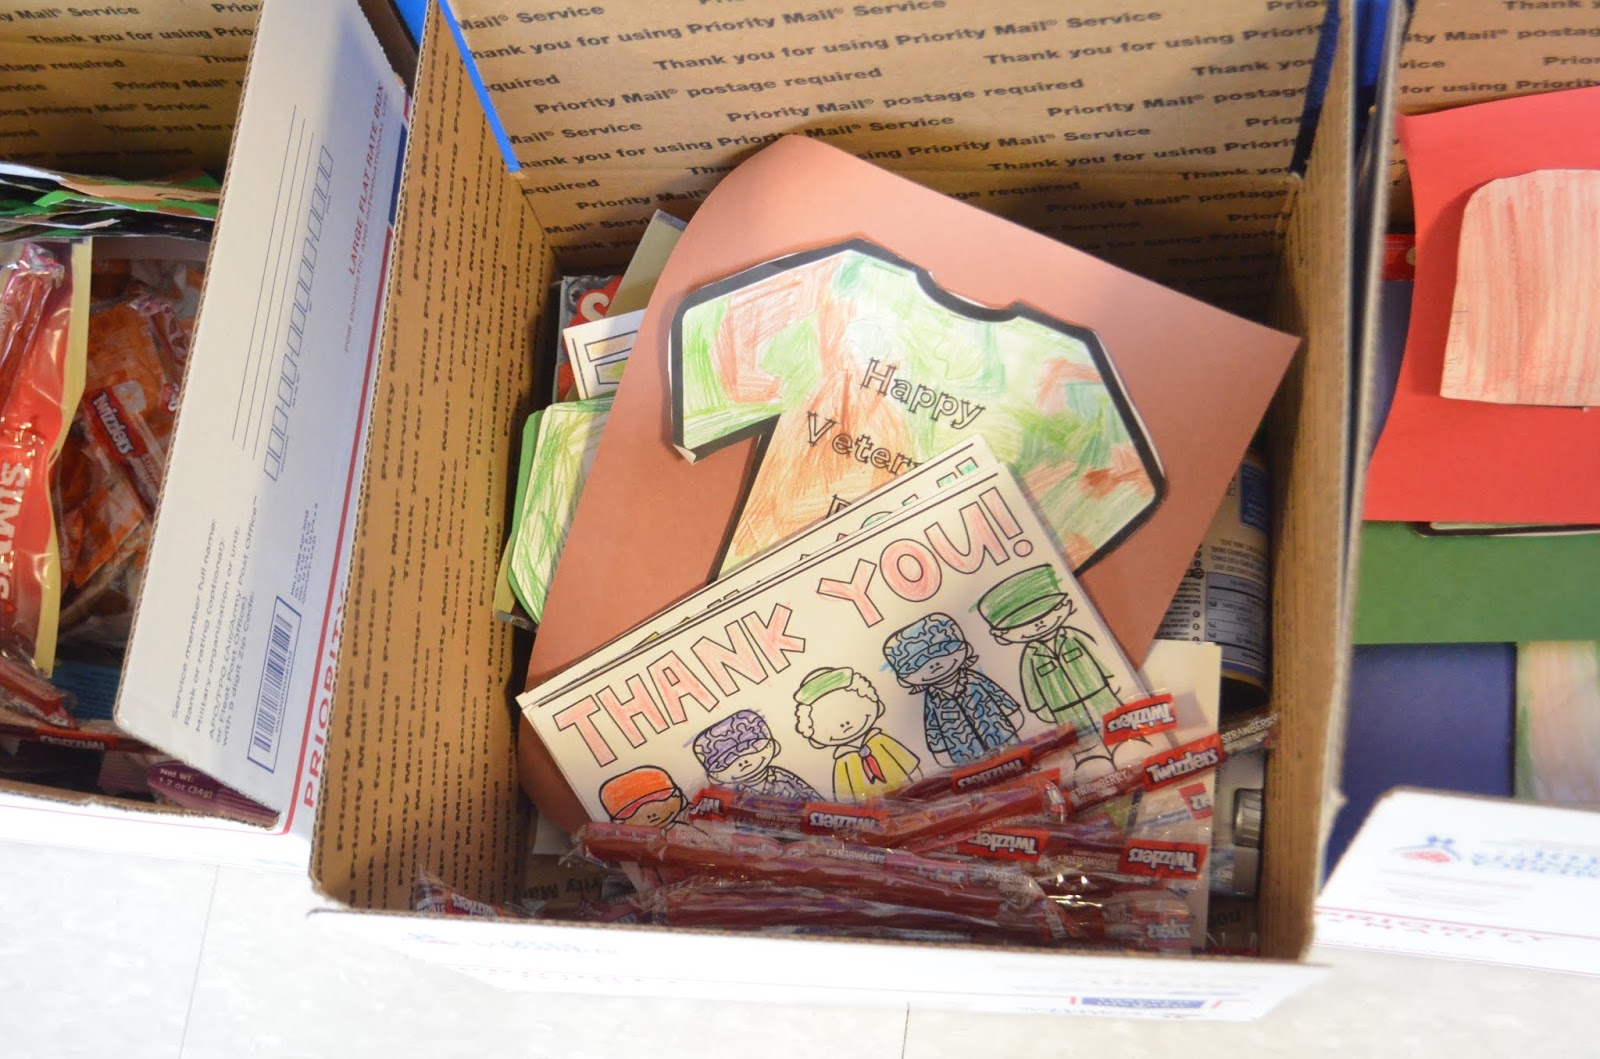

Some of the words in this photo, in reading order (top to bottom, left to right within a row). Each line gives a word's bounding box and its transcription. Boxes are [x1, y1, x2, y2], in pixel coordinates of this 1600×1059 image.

[67, 6, 140, 17] Service
[211, 3, 258, 13] Prior
[516, 6, 605, 23] Service
[1267, 0, 1322, 12] Prio
[1506, 0, 1582, 10] Thank
[26, 34, 93, 44] Thank
[89, 34, 124, 43] you
[126, 31, 153, 40] for
[159, 29, 213, 39] using
[213, 27, 254, 36] Prio
[469, 45, 525, 59] hank
[529, 41, 571, 54] you
[577, 36, 609, 46] for
[617, 28, 682, 42] using
[686, 17, 775, 34] Priority
[853, 0, 946, 16] Service
[653, 55, 727, 70] Thank
[733, 51, 775, 65] you
[781, 47, 815, 57] for
[823, 39, 889, 53] using
[895, 29, 986, 45] Priority
[1066, 12, 1162, 28] Service
[1517, 27, 1600, 40] postag
[984, 49, 1061, 64] Thank
[1069, 46, 1112, 59] you
[1120, 42, 1156, 52] for
[1165, 35, 1234, 48] using
[1242, 25, 1320, 40] Priori
[0, 63, 47, 73] stage
[49, 59, 126, 70] required
[1191, 59, 1269, 77] Thank
[112, 81, 181, 90] Priority
[484, 74, 560, 93] equired
[534, 98, 615, 114] Priority
[686, 81, 776, 98] postage
[784, 67, 882, 86] required
[1400, 85, 1435, 94] for
[1442, 82, 1507, 92] using
[726, 107, 809, 122] Priority
[883, 91, 975, 108] postage
[983, 79, 1084, 96] required
[1047, 103, 1134, 117] Priority
[517, 156, 568, 168] hank
[573, 149, 611, 164] you
[617, 147, 647, 158] for
[653, 142, 713, 153] using
[869, 117, 954, 131] Service
[561, 124, 642, 138] Service
[907, 142, 990, 155] Priority
[1064, 128, 1151, 141] Service
[985, 159, 1058, 171] Thank
[1065, 156, 1105, 167] you
[1113, 153, 1145, 162] for
[1153, 146, 1217, 158] using
[348, 215, 364, 275] LARGE
[358, 171, 370, 212] FLAT
[366, 123, 378, 168] RATE
[374, 80, 385, 119] BOX
[525, 179, 600, 196] equired
[1177, 168, 1251, 181] Thank
[988, 182, 1080, 197] required
[1198, 190, 1289, 203] postage
[575, 197, 650, 210] Priority
[860, 357, 986, 430] Happy
[92, 391, 135, 455] Twizzlers
[808, 411, 920, 475] Veter
[172, 663, 188, 718] Service
[183, 594, 200, 659] member
[197, 567, 208, 591] full
[203, 518, 217, 564] name:
[196, 677, 213, 732] Military
[209, 580, 230, 674] organization
[227, 561, 233, 577] or
[230, 527, 239, 558] unit:
[553, 603, 805, 766] THANK
[817, 487, 1032, 627] YOU!
[184, 687, 196, 726] Rank
[193, 667, 199, 684] or
[197, 619, 211, 664] rating
[205, 538, 225, 615] (optional):
[209, 665, 228, 740] APO/FPO
[240, 553, 250, 585] Post
[223, 714, 233, 747] with
[230, 664, 242, 699] digit
[241, 591, 255, 633] Code:
[227, 650, 237, 682] Post
[218, 686, 230, 723] Fleet
[1107, 701, 1175, 733] Twizzlers
[217, 727, 222, 743] or
[957, 759, 1027, 789] Twizzlers
[1146, 749, 1220, 783] Twizzlers
[1128, 848, 1198, 872] Twizzlers
